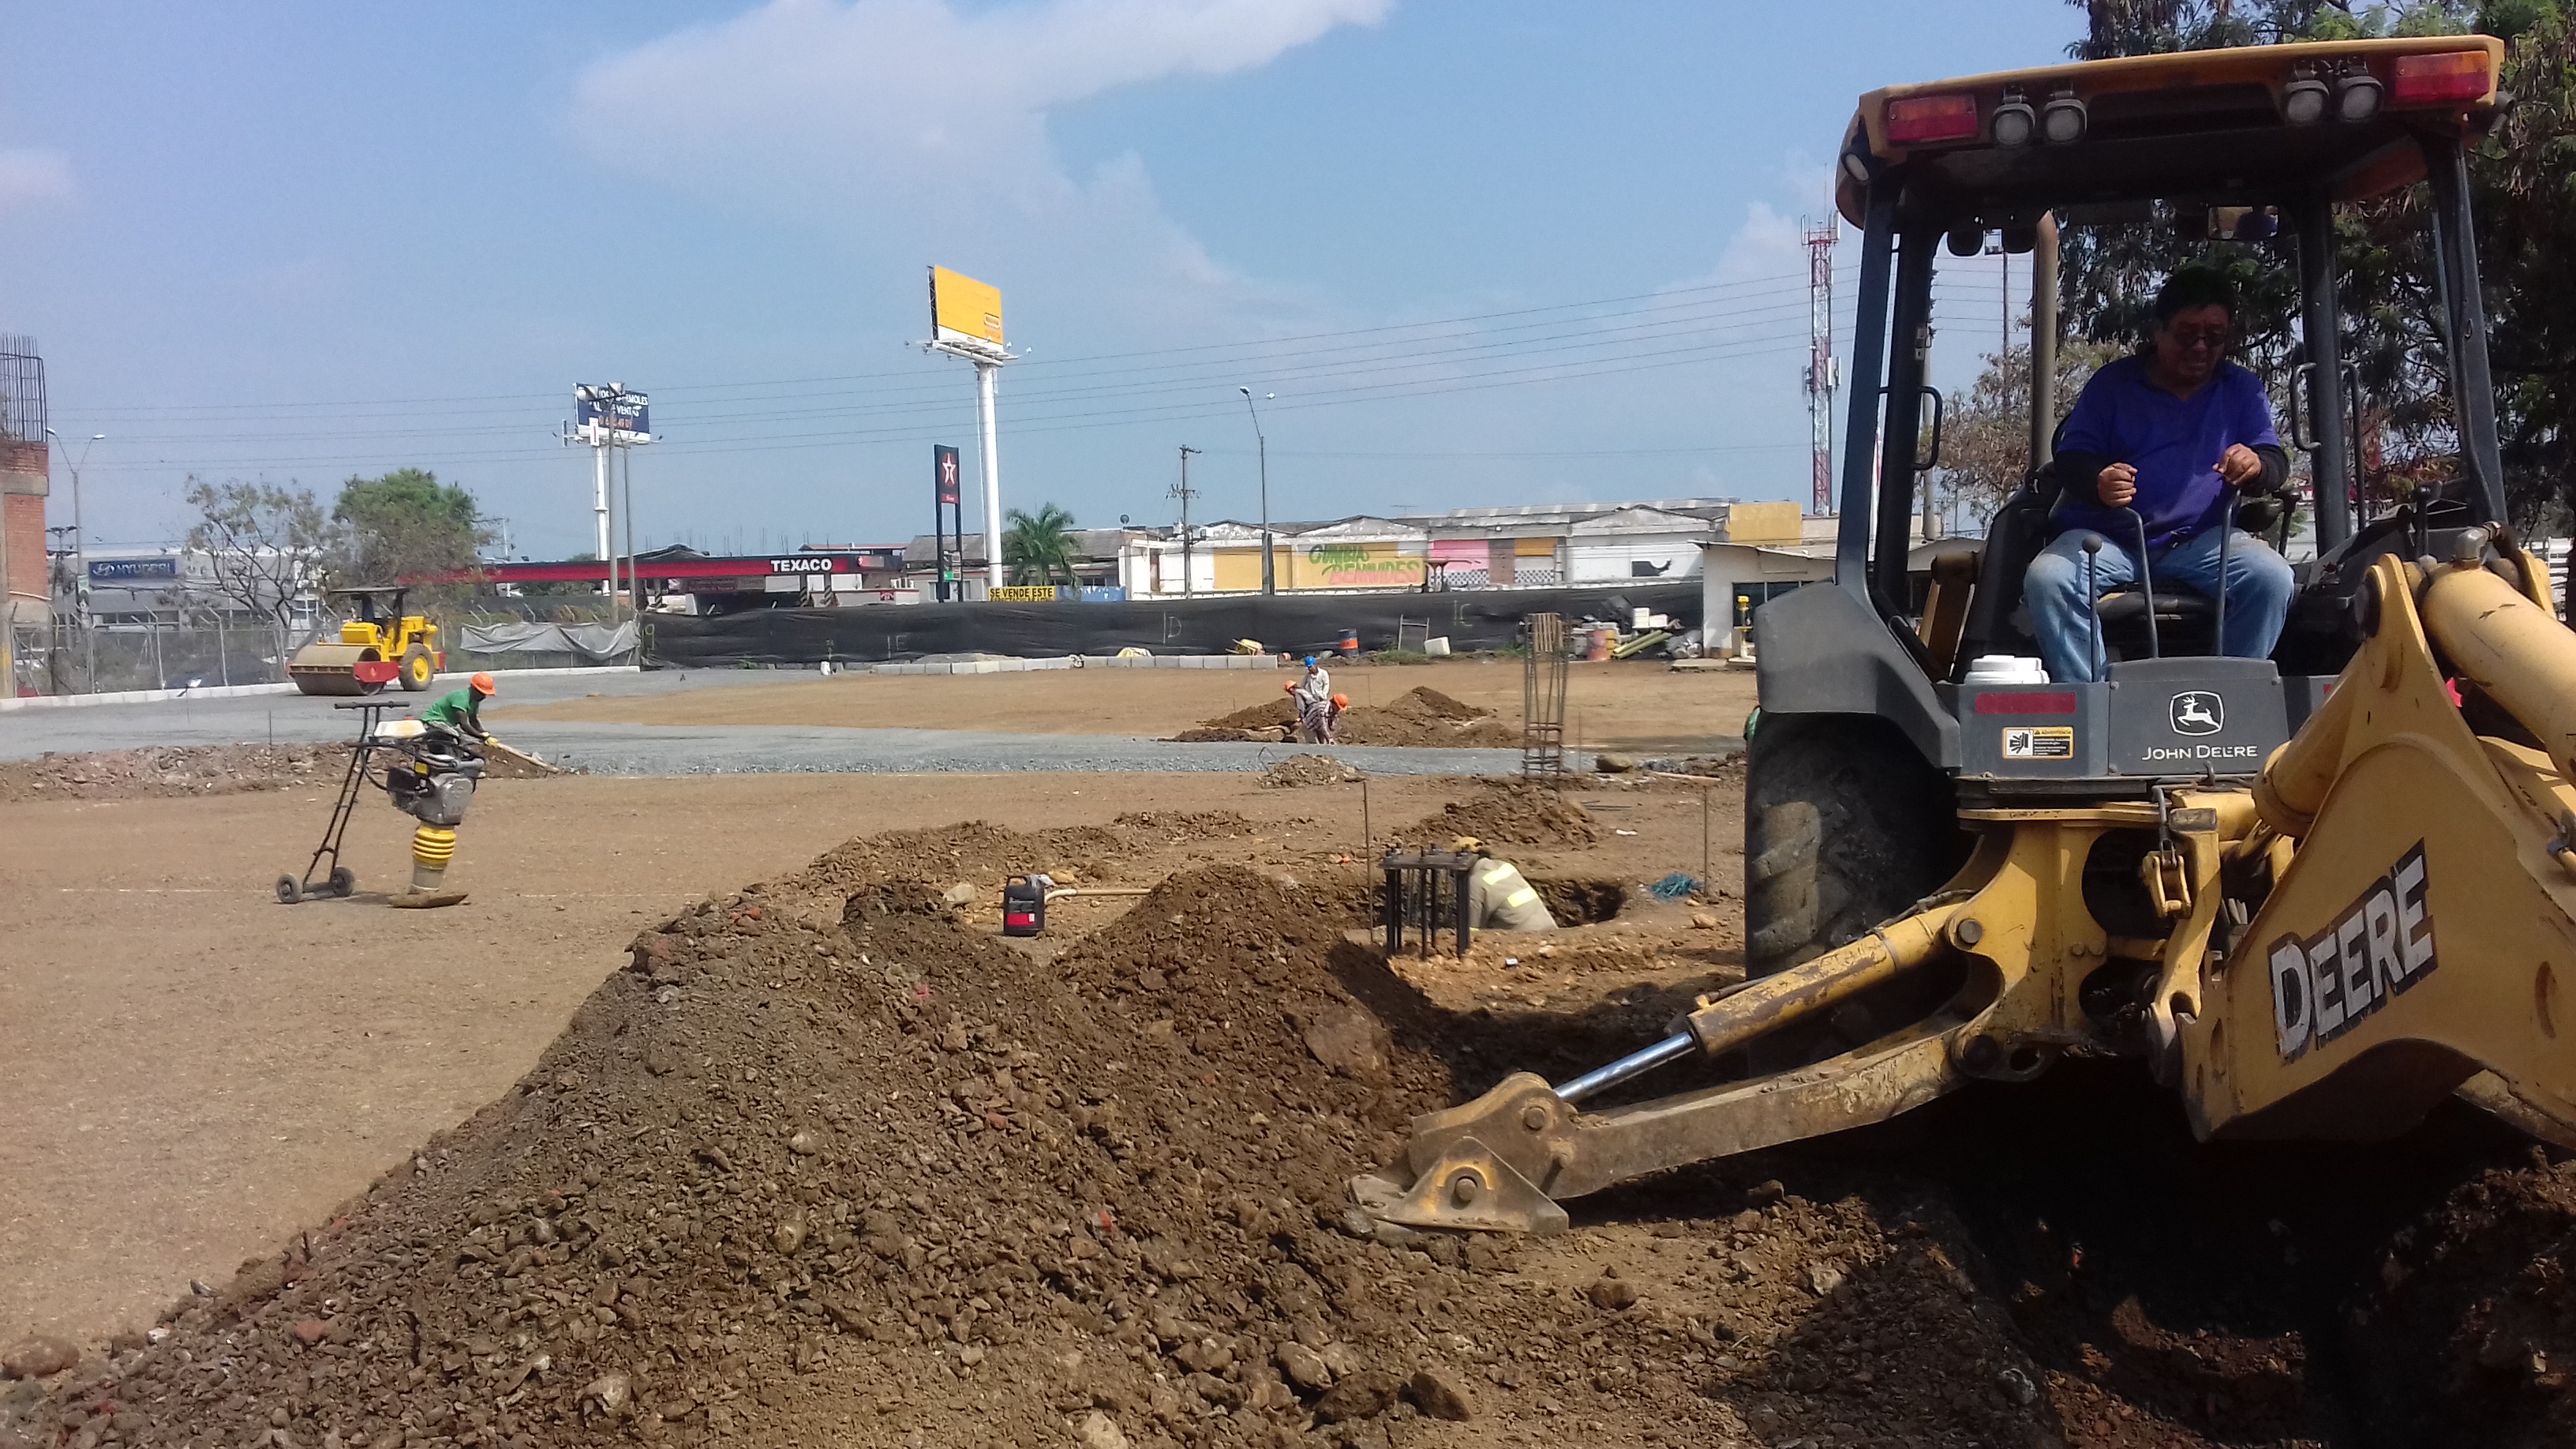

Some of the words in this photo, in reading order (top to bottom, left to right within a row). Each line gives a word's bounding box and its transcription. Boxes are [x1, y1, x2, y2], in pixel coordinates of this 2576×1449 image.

[770, 558, 833, 572] TEXACO
[990, 587, 1001, 598] SE
[1002, 587, 1031, 598] VENDE
[1032, 587, 1053, 598] ESTE
[2141, 746, 2192, 761] JOHN
[2196, 744, 2258, 759] DEERE
[2270, 852, 2434, 1056] DEERE
